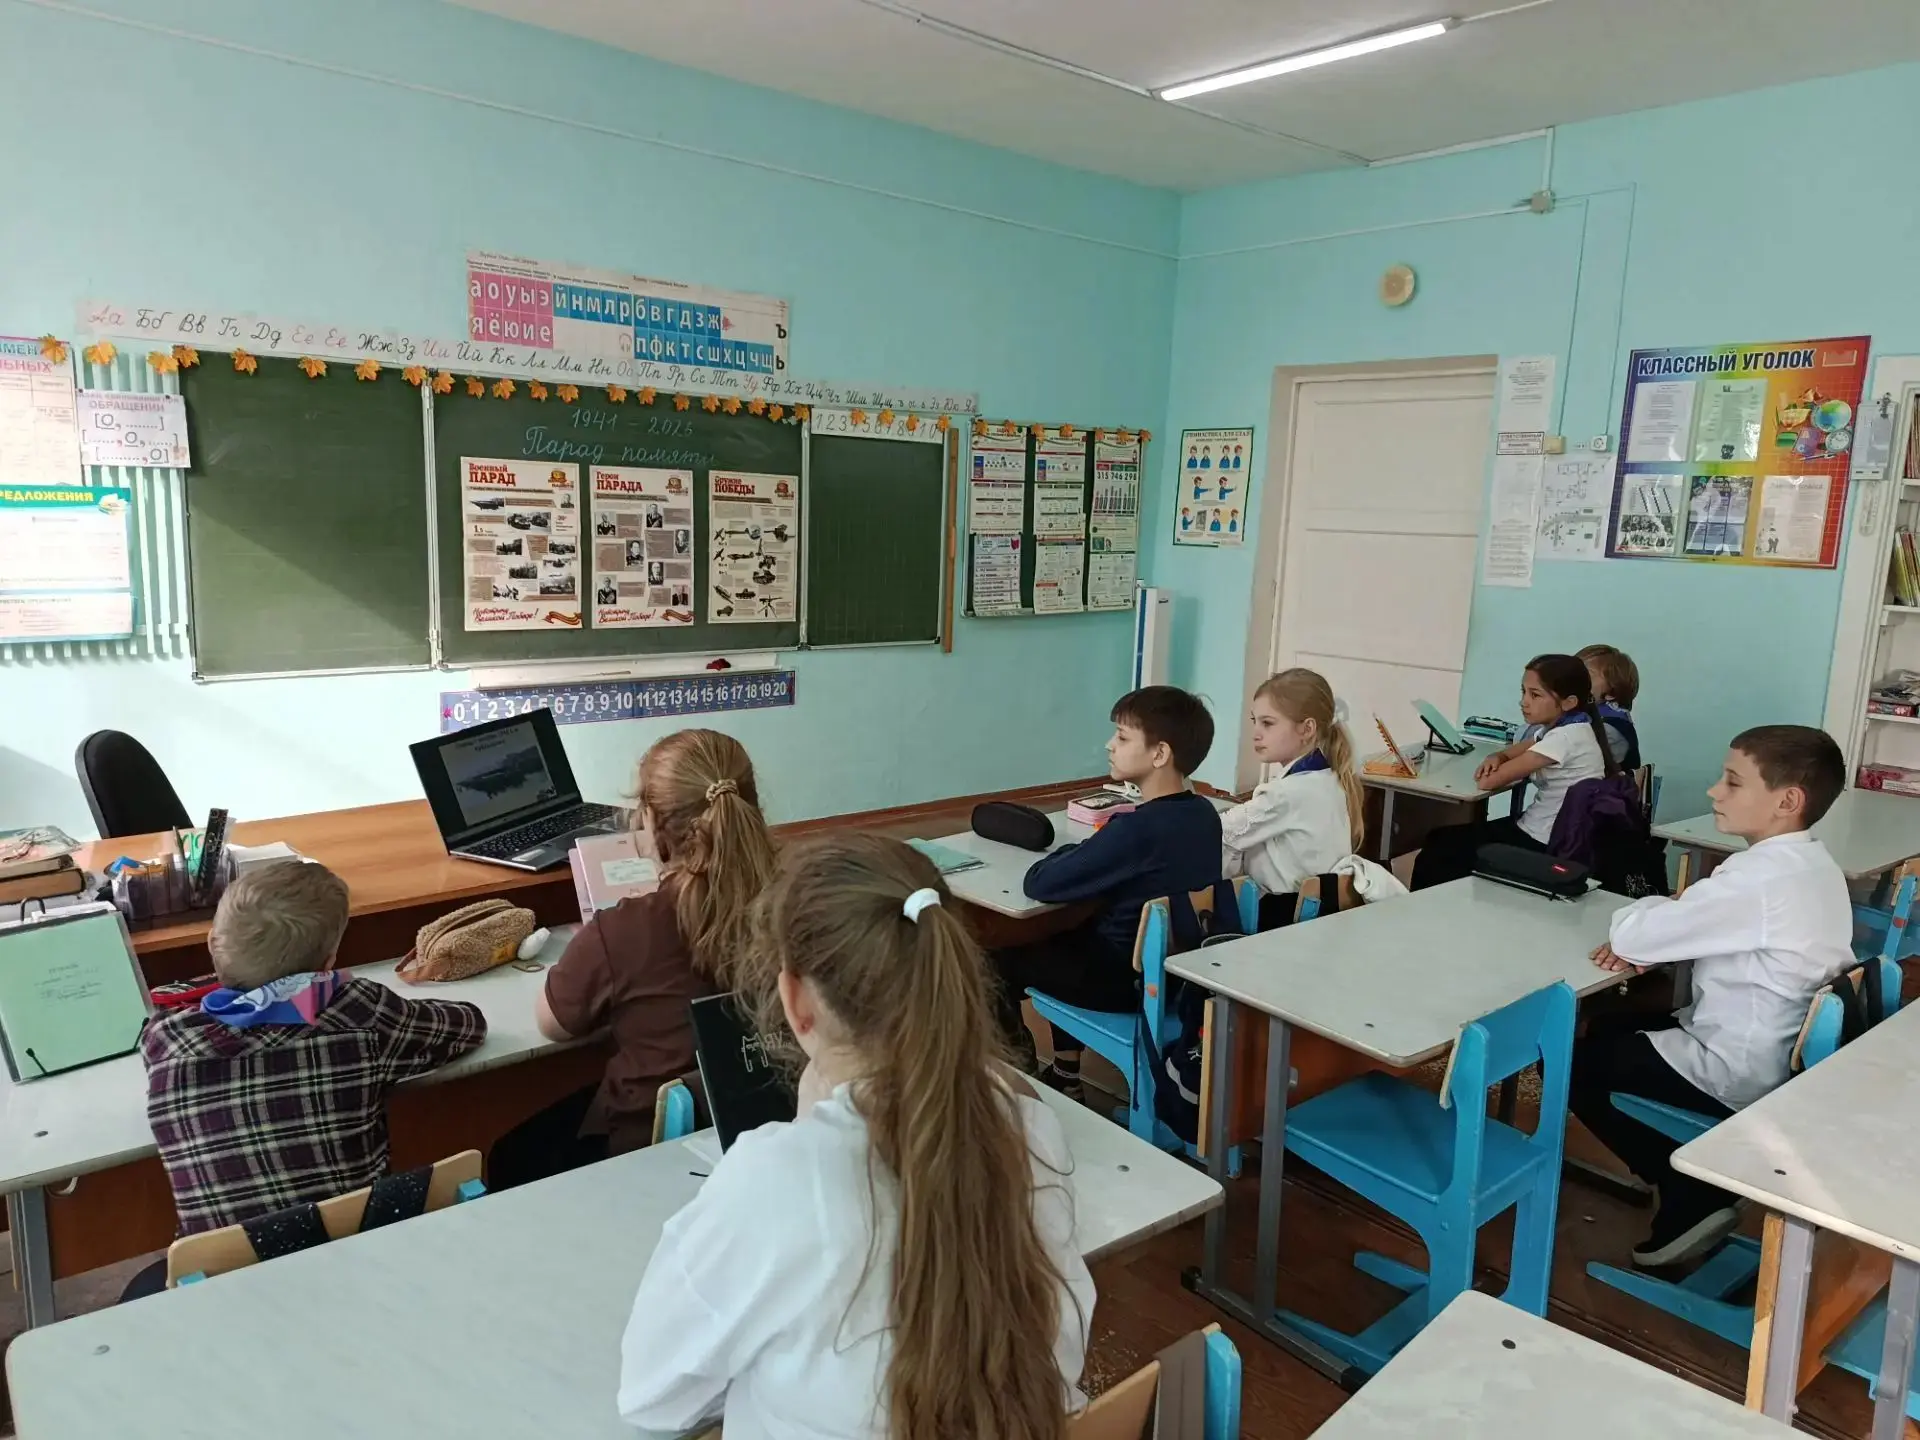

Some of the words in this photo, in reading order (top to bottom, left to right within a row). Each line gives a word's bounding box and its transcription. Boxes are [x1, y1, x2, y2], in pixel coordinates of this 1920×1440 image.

[0, 343, 38, 355] МЕН
[0, 359, 51, 373] ЬНЫХ
[1639, 349, 1737, 375] КЛАССНЫЙ
[1742, 350, 1816, 370] УГОЛОК
[89, 400, 164, 412] ОБРАЩЕНИИ
[572, 408, 618, 432] 1941
[816, 413, 823, 430] 1
[826, 414, 835, 430] 2
[839, 415, 847, 431] 3
[897, 420, 905, 436] 8
[522, 426, 604, 464] Парад
[622, 445, 715, 465] памяти
[469, 462, 508, 472] Военный
[469, 472, 516, 486] ПАРАД
[596, 471, 619, 480] Герои
[714, 476, 742, 485] Оружие
[596, 480, 643, 493] ПАРАДА
[714, 484, 755, 495] ПОБЕДЫ
[454, 704, 465, 721] 0
[471, 703, 479, 721] 1
[488, 702, 498, 718] 2
[505, 700, 515, 718] 3
[521, 699, 532, 713] 4
[554, 697, 564, 713] 6
[569, 696, 579, 712] 7
[585, 695, 594, 711] 8
[600, 694, 609, 710] 9
[615, 692, 632, 709] 10
[637, 692, 649, 707] 11
[652, 691, 666, 706] 12
[669, 690, 682, 704] 13
[685, 689, 698, 703] 14
[701, 688, 713, 702] 15
[716, 686, 728, 700] 16
[731, 685, 743, 699] 17
[745, 684, 757, 698] 18
[759, 682, 771, 696] 19
[773, 681, 786, 695] 20
